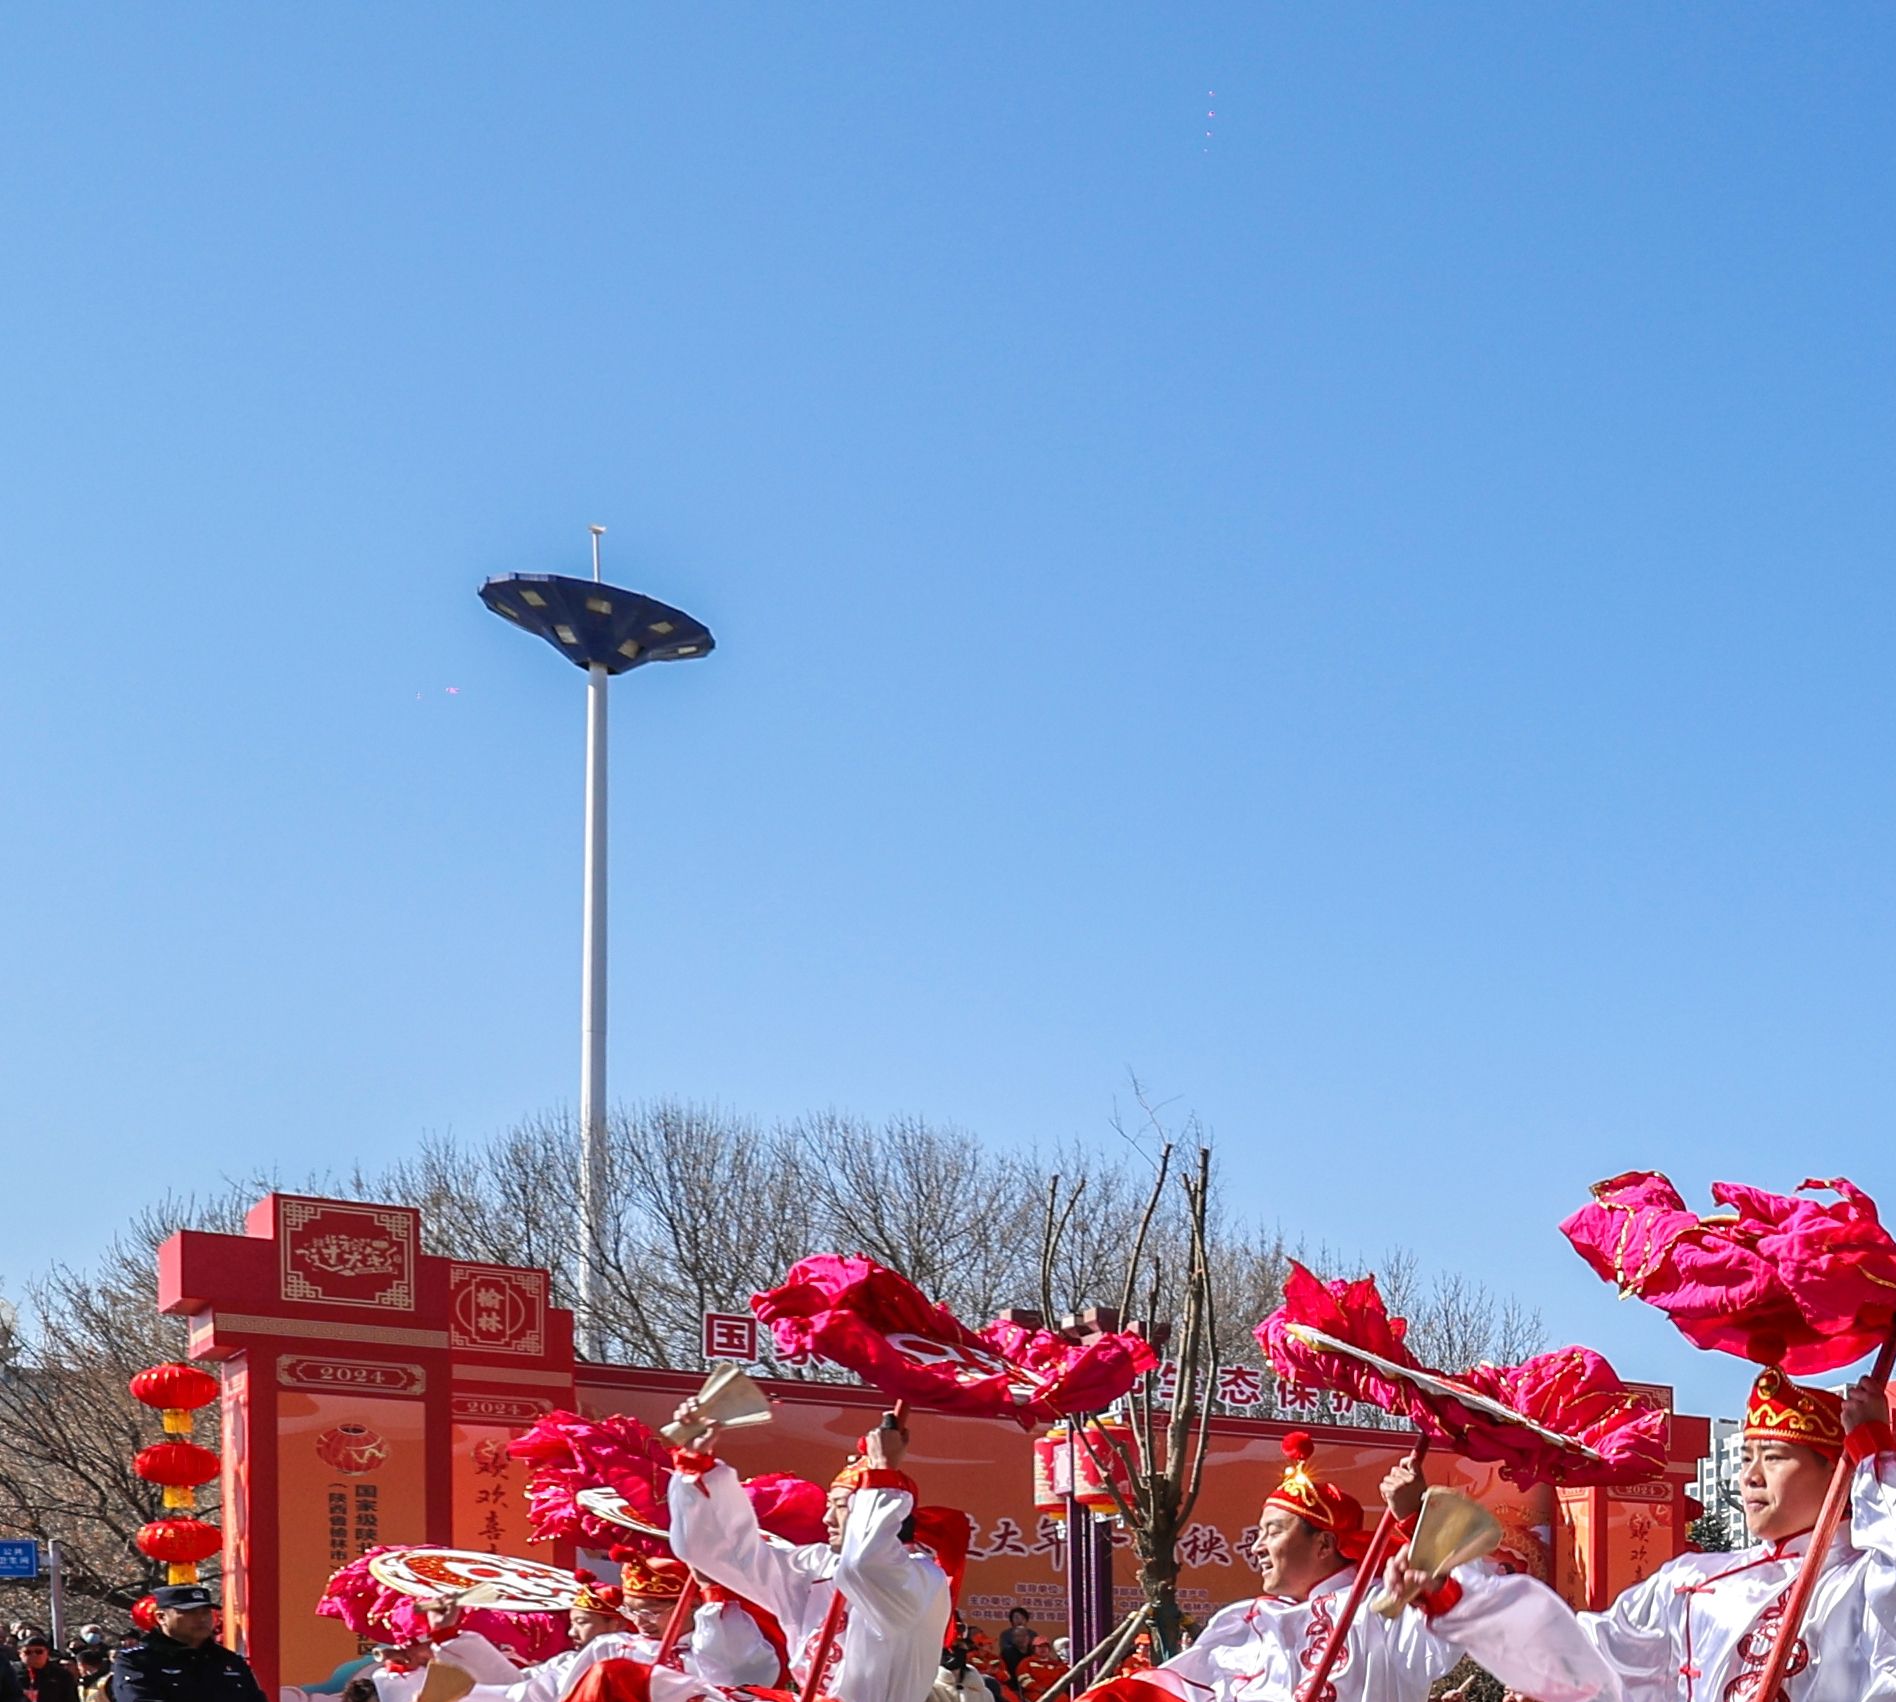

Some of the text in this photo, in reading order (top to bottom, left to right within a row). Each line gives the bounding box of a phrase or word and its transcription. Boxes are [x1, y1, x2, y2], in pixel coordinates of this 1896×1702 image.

[476, 1287, 504, 1333] 榆林
[320, 1366, 386, 1384] 2024
[467, 1400, 521, 1416] 2024
